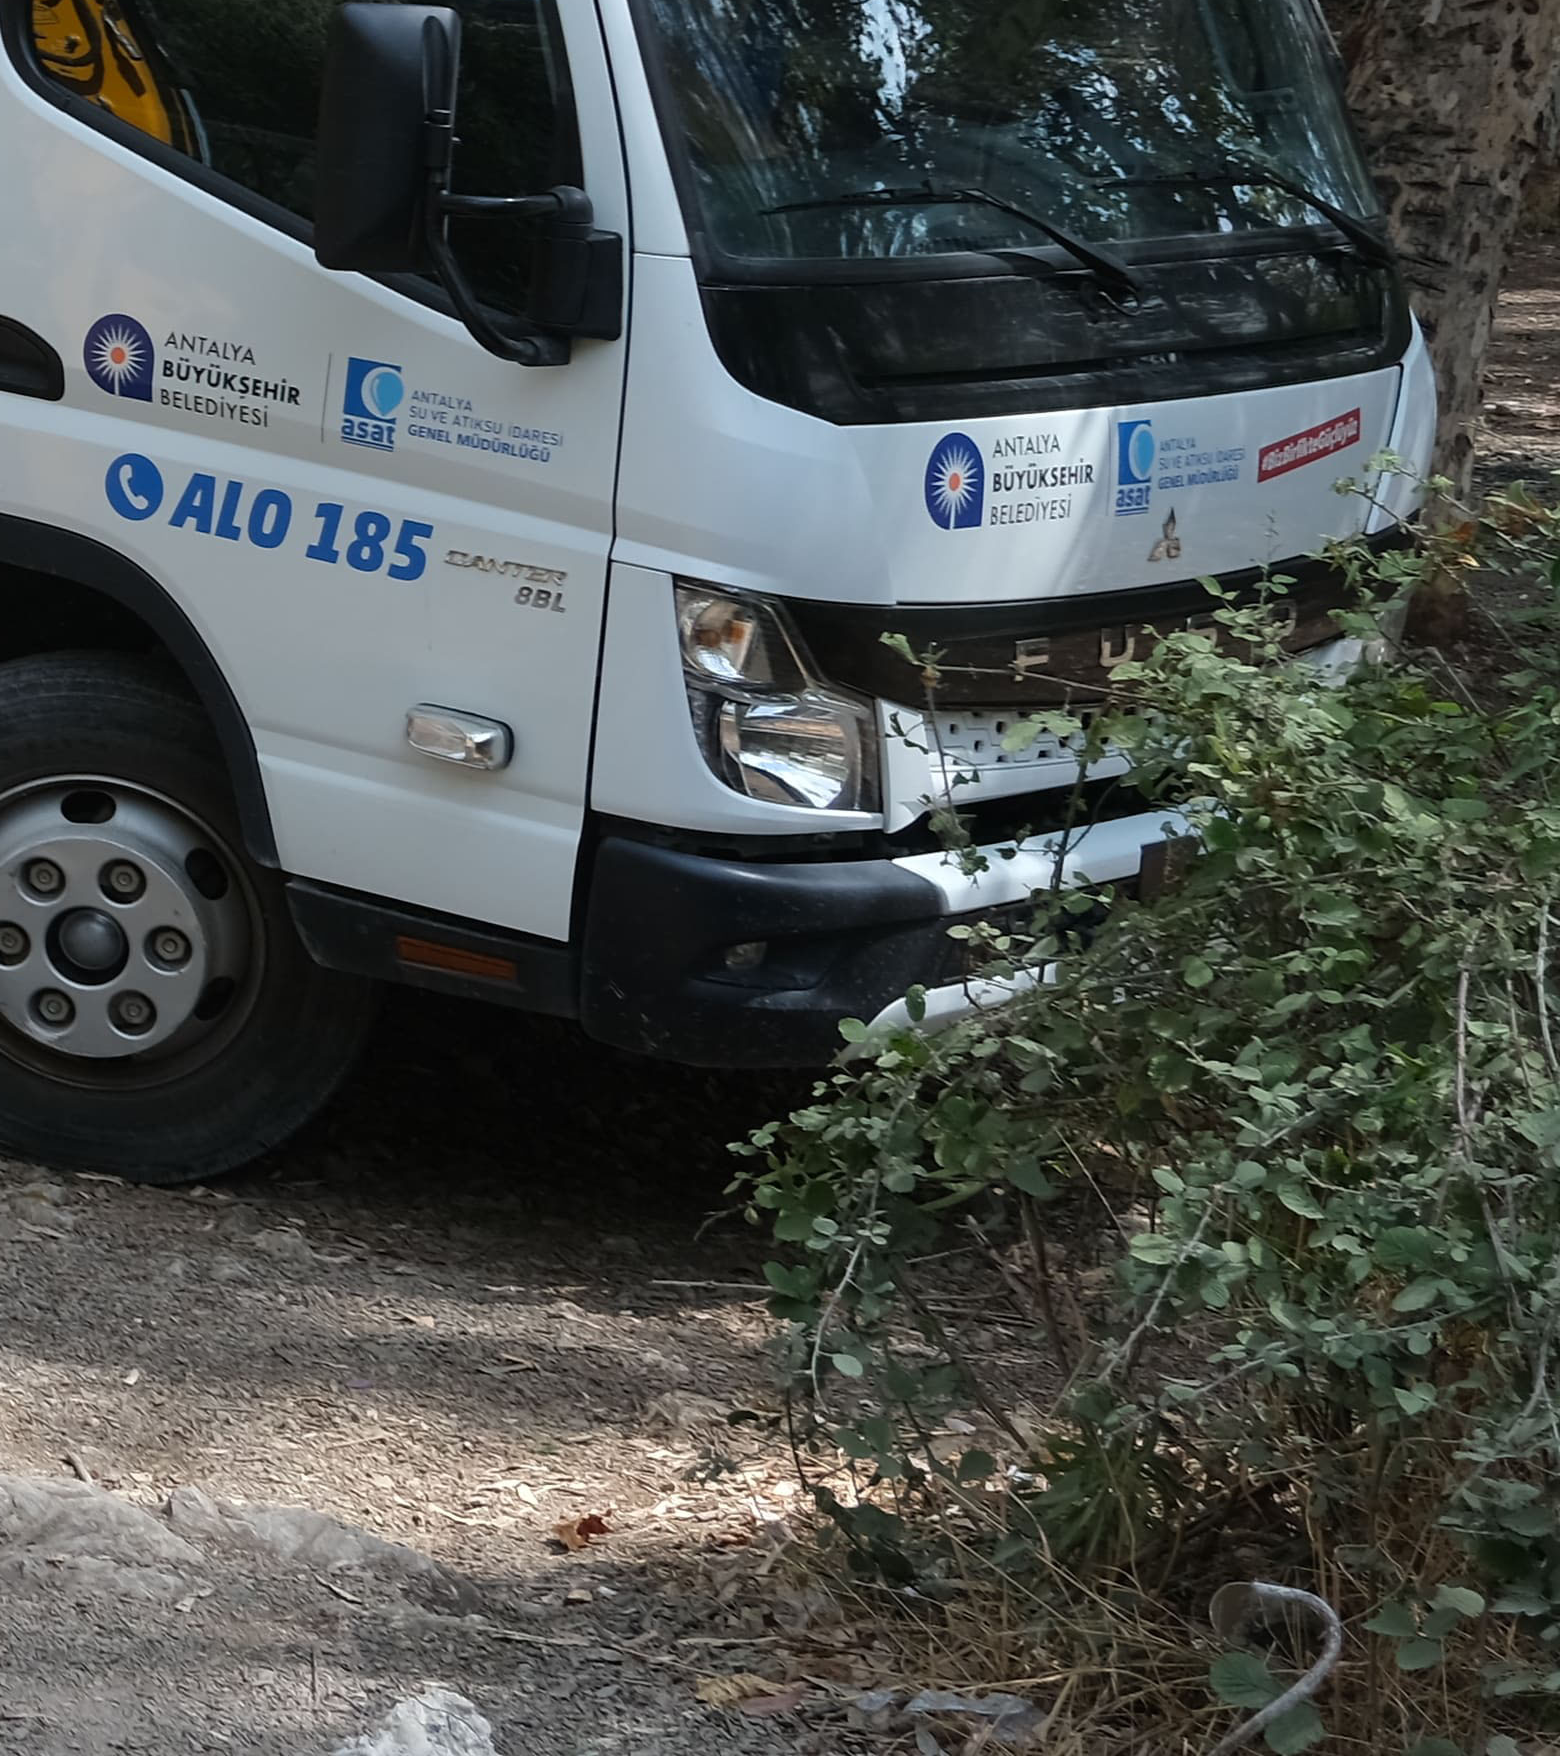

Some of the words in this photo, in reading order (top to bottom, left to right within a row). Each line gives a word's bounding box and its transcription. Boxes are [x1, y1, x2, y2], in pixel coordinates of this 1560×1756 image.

[164, 332, 256, 366] ANTALYA
[163, 357, 300, 406] BÜYÜKŞEHİR
[160, 388, 268, 428] BELEDİYESİ
[412, 390, 472, 412] ANTALYA
[341, 418, 396, 445] asat
[409, 405, 427, 420] SU
[431, 411, 448, 424] VE
[452, 415, 503, 435] ATIKSU
[407, 424, 453, 444] GENEL
[456, 433, 551, 462] MÜDÜRLÜĞÜ
[992, 434, 1061, 458] ANTALYA
[990, 494, 1072, 525] BELEDİYESİ
[1116, 485, 1151, 508] asat
[168, 473, 292, 549] ALO
[306, 502, 434, 582] 185
[443, 549, 568, 587] CANTER
[514, 586, 567, 614] 8BL
